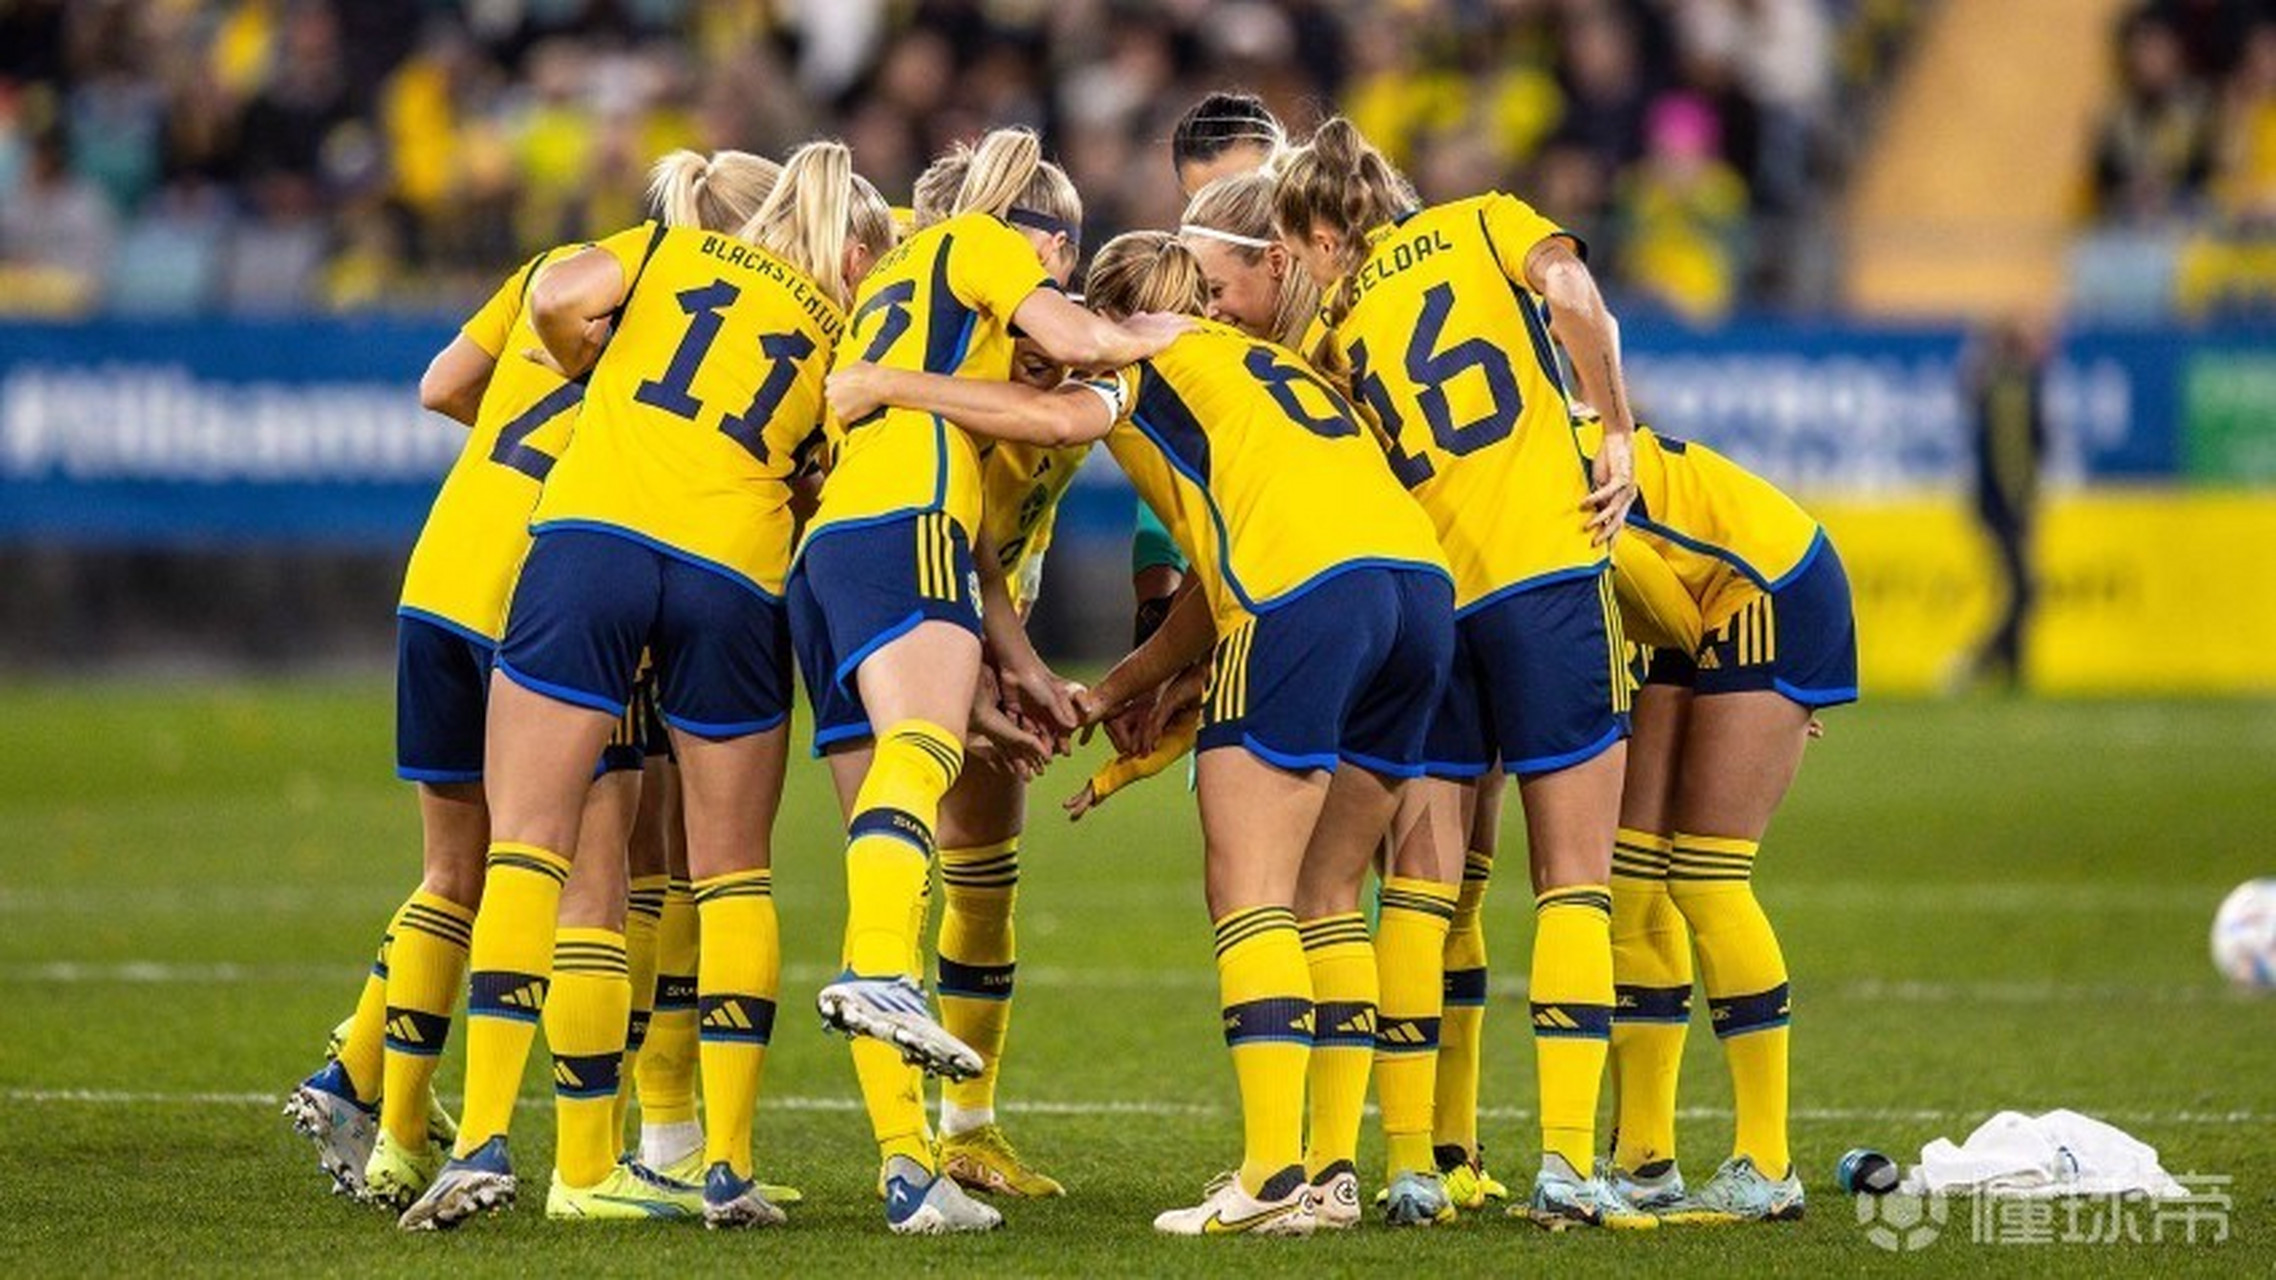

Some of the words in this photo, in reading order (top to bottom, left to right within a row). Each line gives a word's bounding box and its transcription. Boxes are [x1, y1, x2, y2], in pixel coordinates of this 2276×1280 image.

[634, 278, 815, 465] 11
[1243, 346, 1361, 439] 6
[1347, 281, 1523, 491] 16
